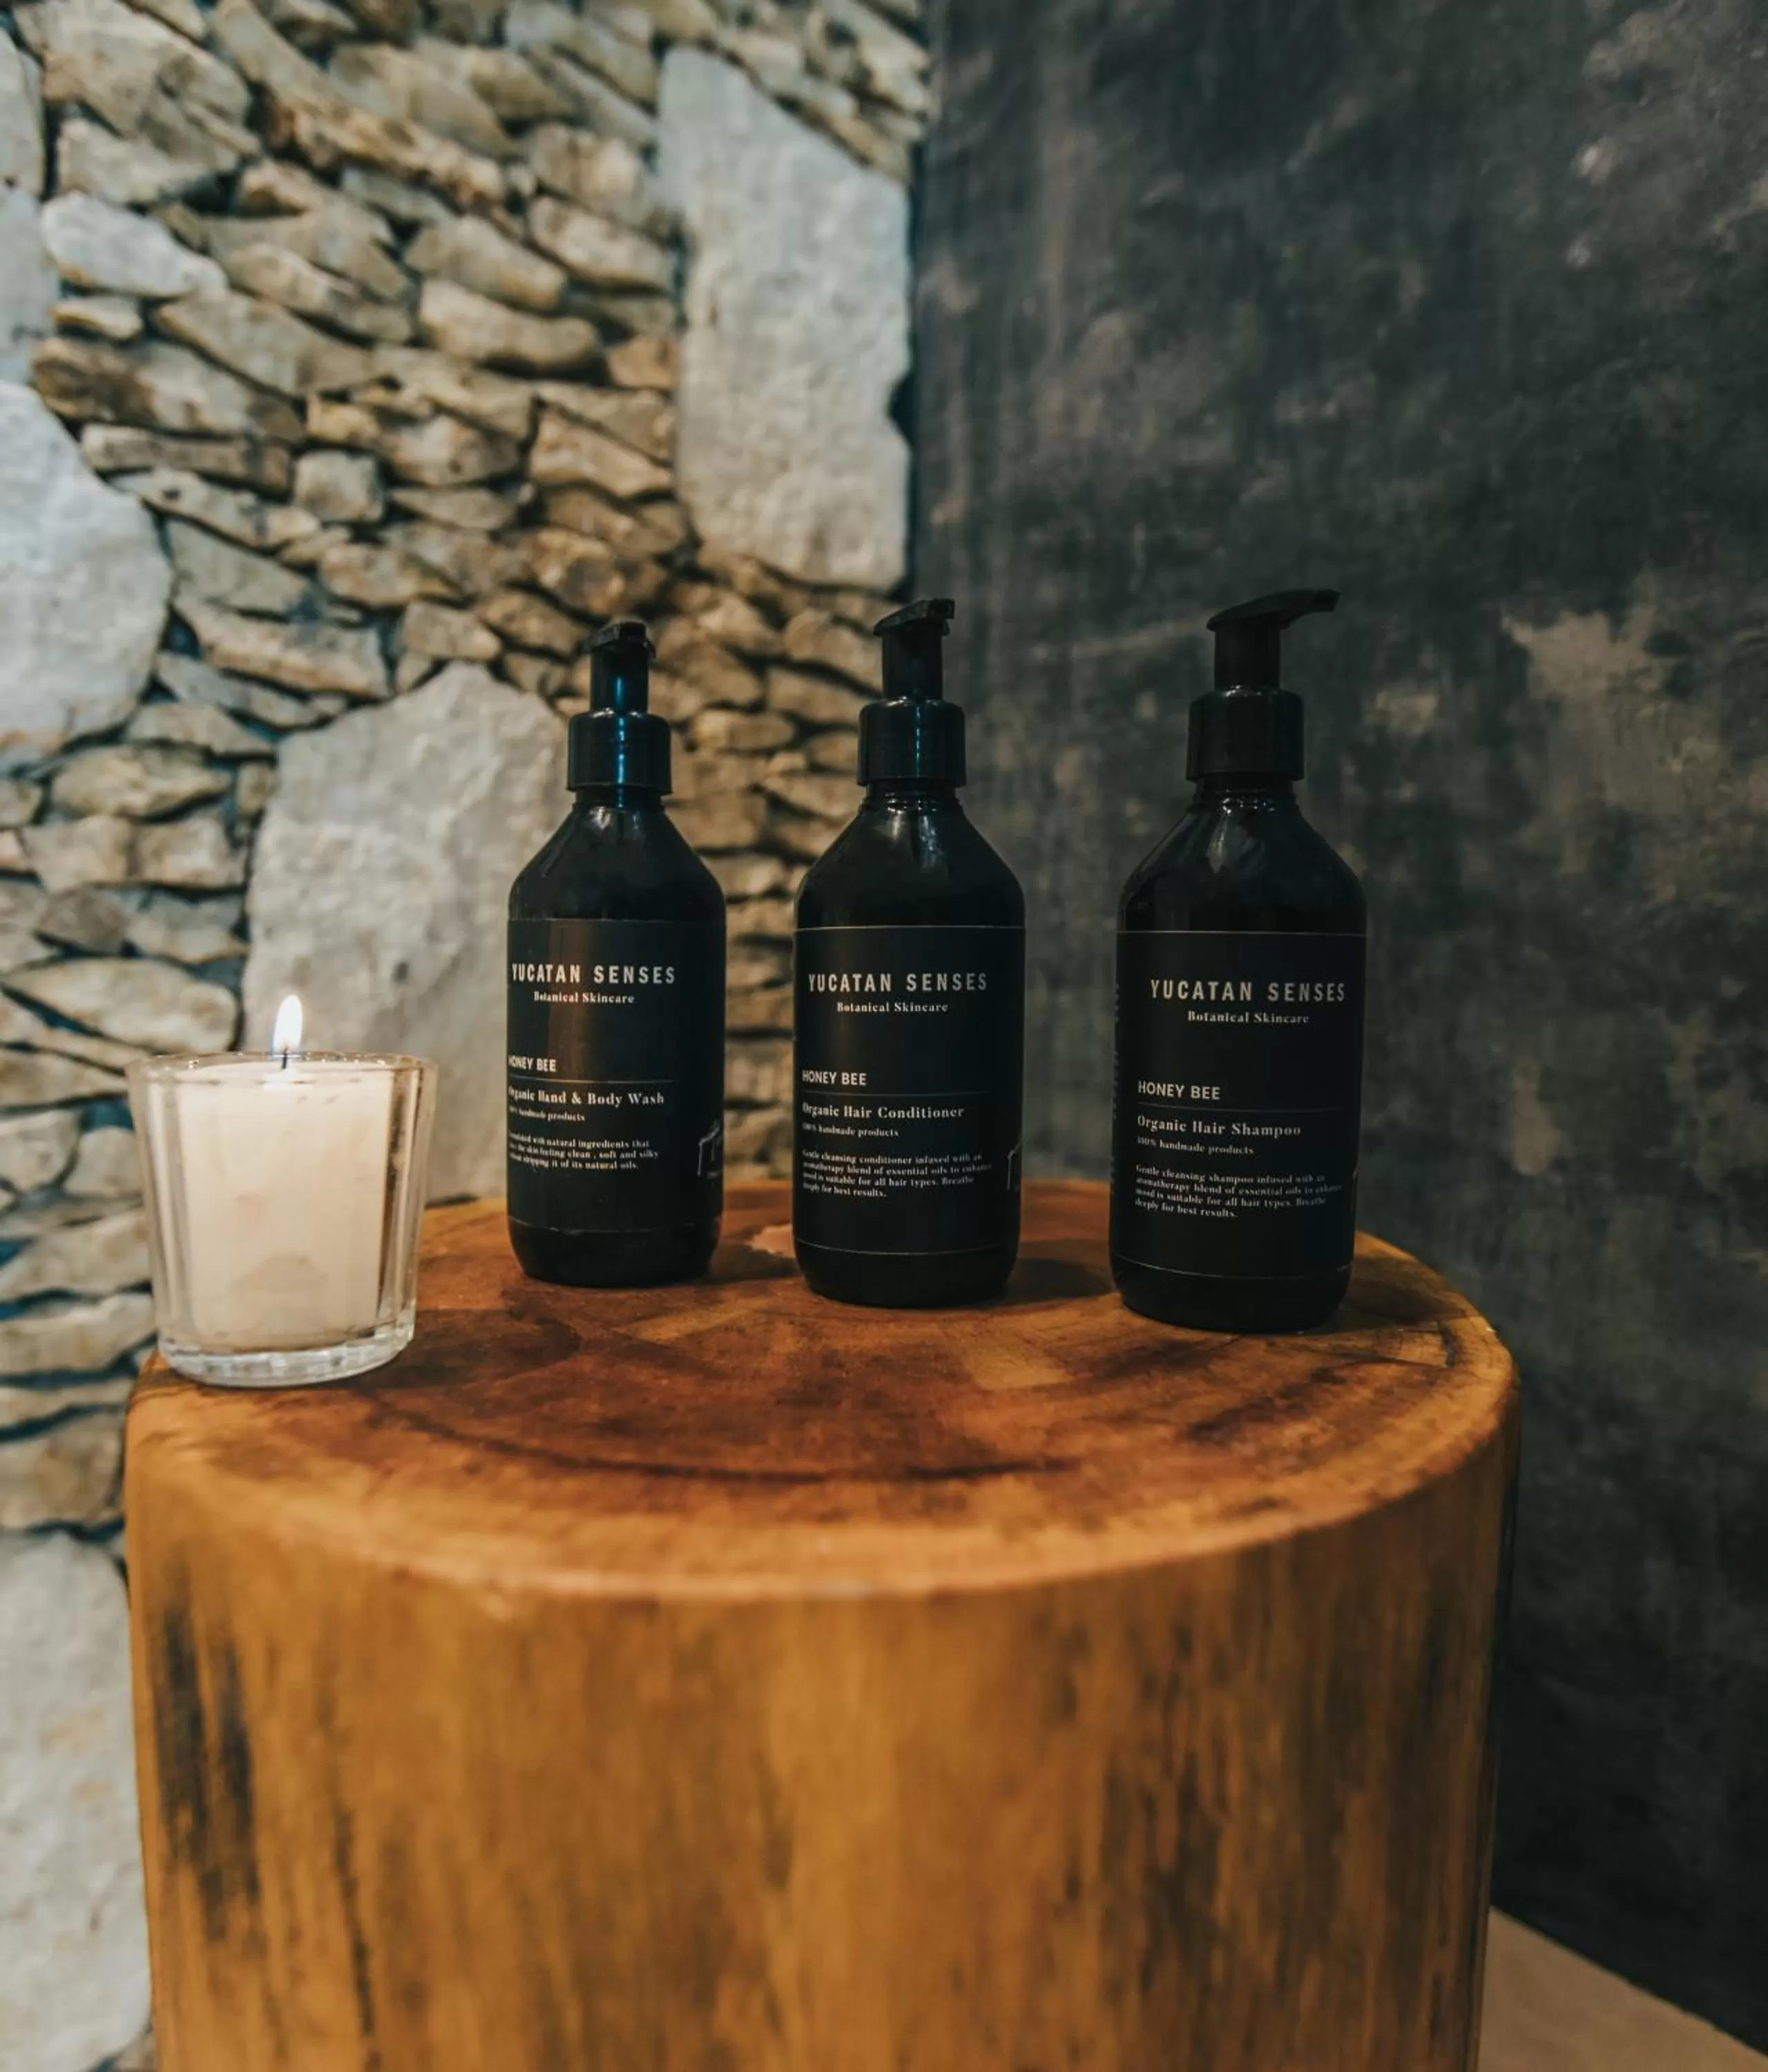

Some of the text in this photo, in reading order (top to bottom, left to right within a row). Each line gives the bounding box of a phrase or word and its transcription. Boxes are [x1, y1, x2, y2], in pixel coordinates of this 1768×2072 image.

[512, 963, 675, 984] YUCATAN SENSES
[809, 972, 987, 992] YUCATAN SENSES
[534, 990, 635, 1004] Botanical Skincare
[1151, 979, 1345, 1002] YUCATAN SENSES
[836, 1001, 948, 1013] Botanical Skincare
[1187, 1010, 1310, 1024] Botanical Skincare
[508, 1055, 557, 1072] HONEY BEE
[803, 1069, 867, 1086] HONEY BEE
[1137, 1080, 1221, 1100] HONEY BEE
[538, 1089, 566, 1104] Hand
[571, 1091, 582, 1104] &
[588, 1092, 622, 1109] Body
[627, 1091, 664, 1104] Wash
[548, 1111, 586, 1122] products
[802, 1102, 965, 1119] Organic Hair Conditioner
[858, 1128, 899, 1138] products
[1137, 1115, 1301, 1139] Organic Hair Shampoo
[578, 1139, 630, 1150] ingredients
[632, 1139, 650, 1148] that
[1160, 1139, 1205, 1153] handmade
[1208, 1144, 1254, 1155] products
[585, 1160, 617, 1169] natural
[859, 1155, 912, 1164] conditioner
[874, 1167, 883, 1175] of
[886, 1166, 928, 1175] essential
[874, 1178, 886, 1186] all
[889, 1178, 907, 1187] hair
[1224, 1186, 1235, 1194] of
[1238, 1187, 1282, 1196] essential
[1224, 1197, 1238, 1207] all
[1241, 1197, 1260, 1207] hair
[1177, 1205, 1198, 1215] best
